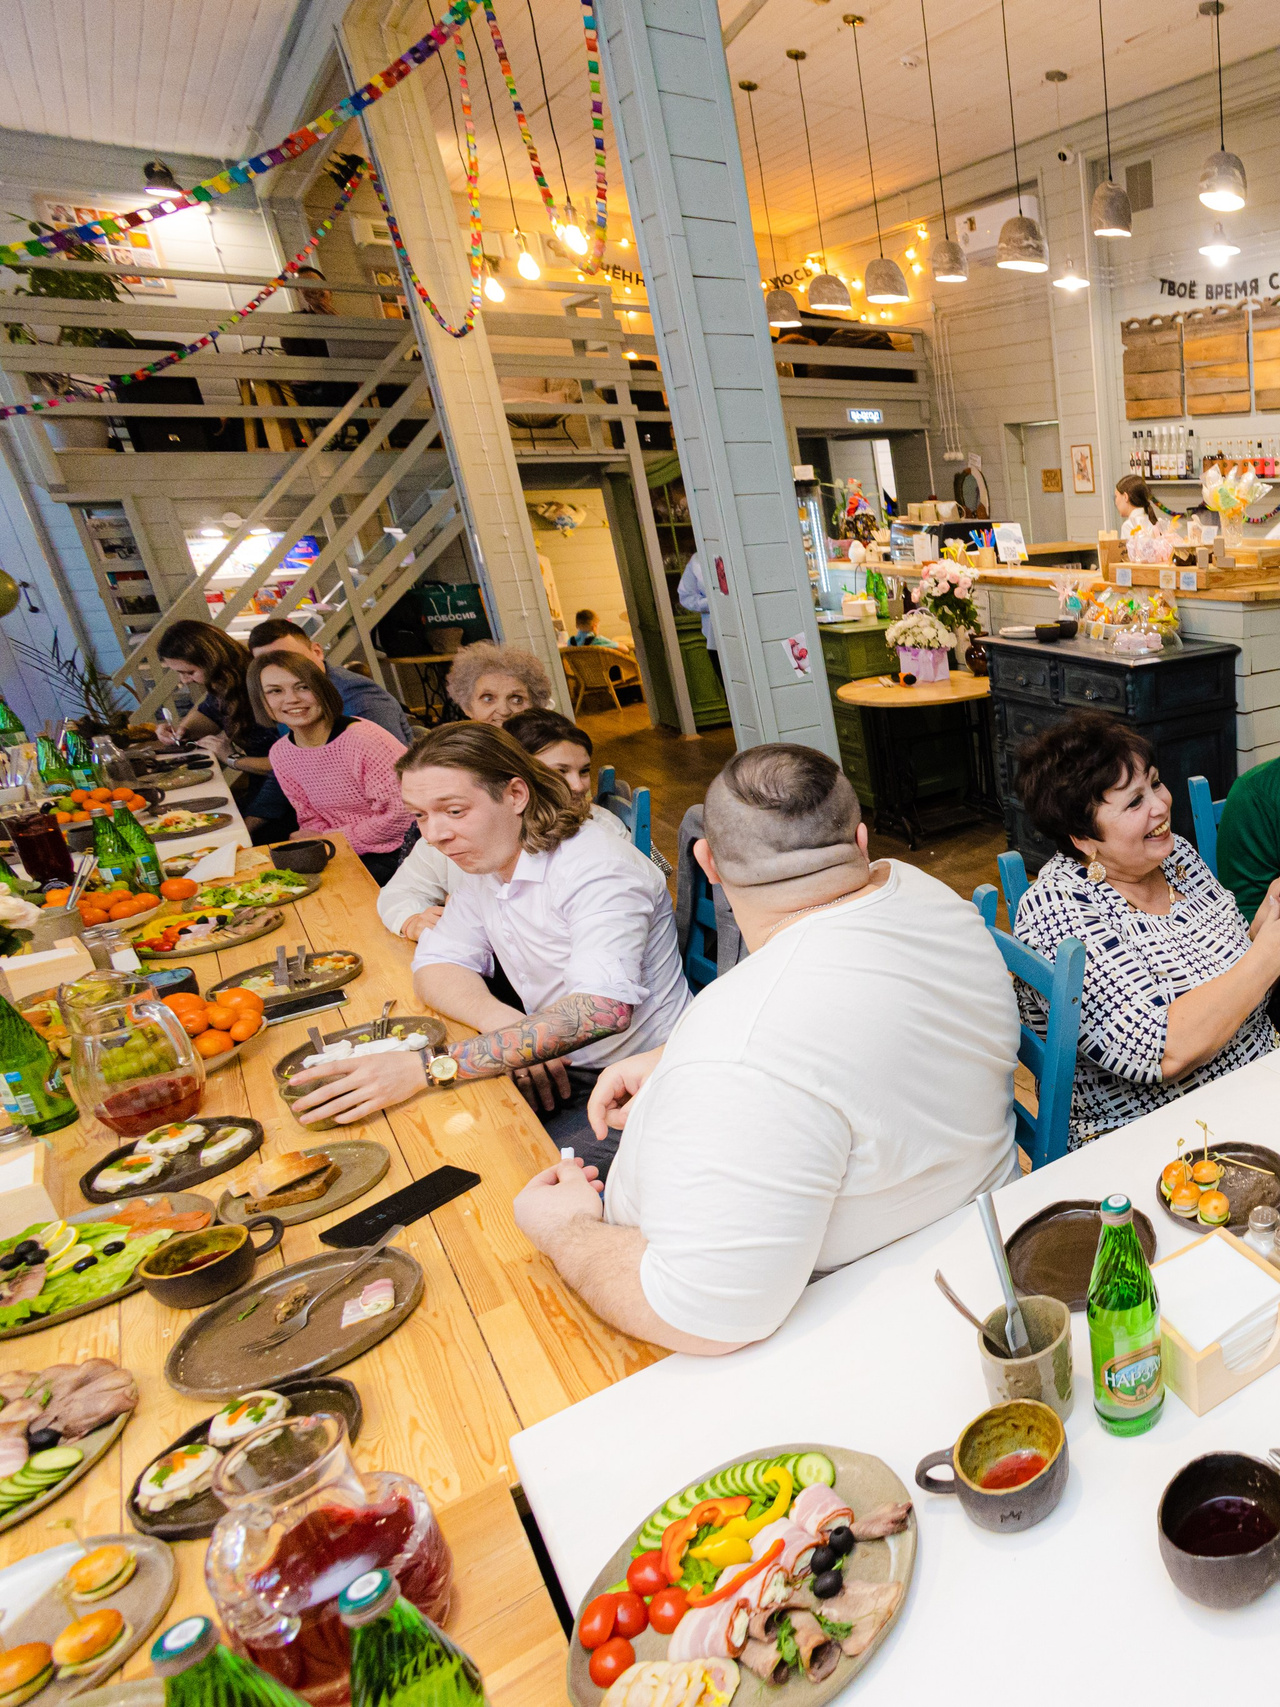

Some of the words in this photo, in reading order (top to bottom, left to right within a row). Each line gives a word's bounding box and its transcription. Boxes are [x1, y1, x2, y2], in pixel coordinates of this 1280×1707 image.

[1159, 278, 1197, 299] ТВОЁ
[1205, 278, 1259, 300] ВРЕМЯ
[427, 611, 477, 623] РОБОСИБ
